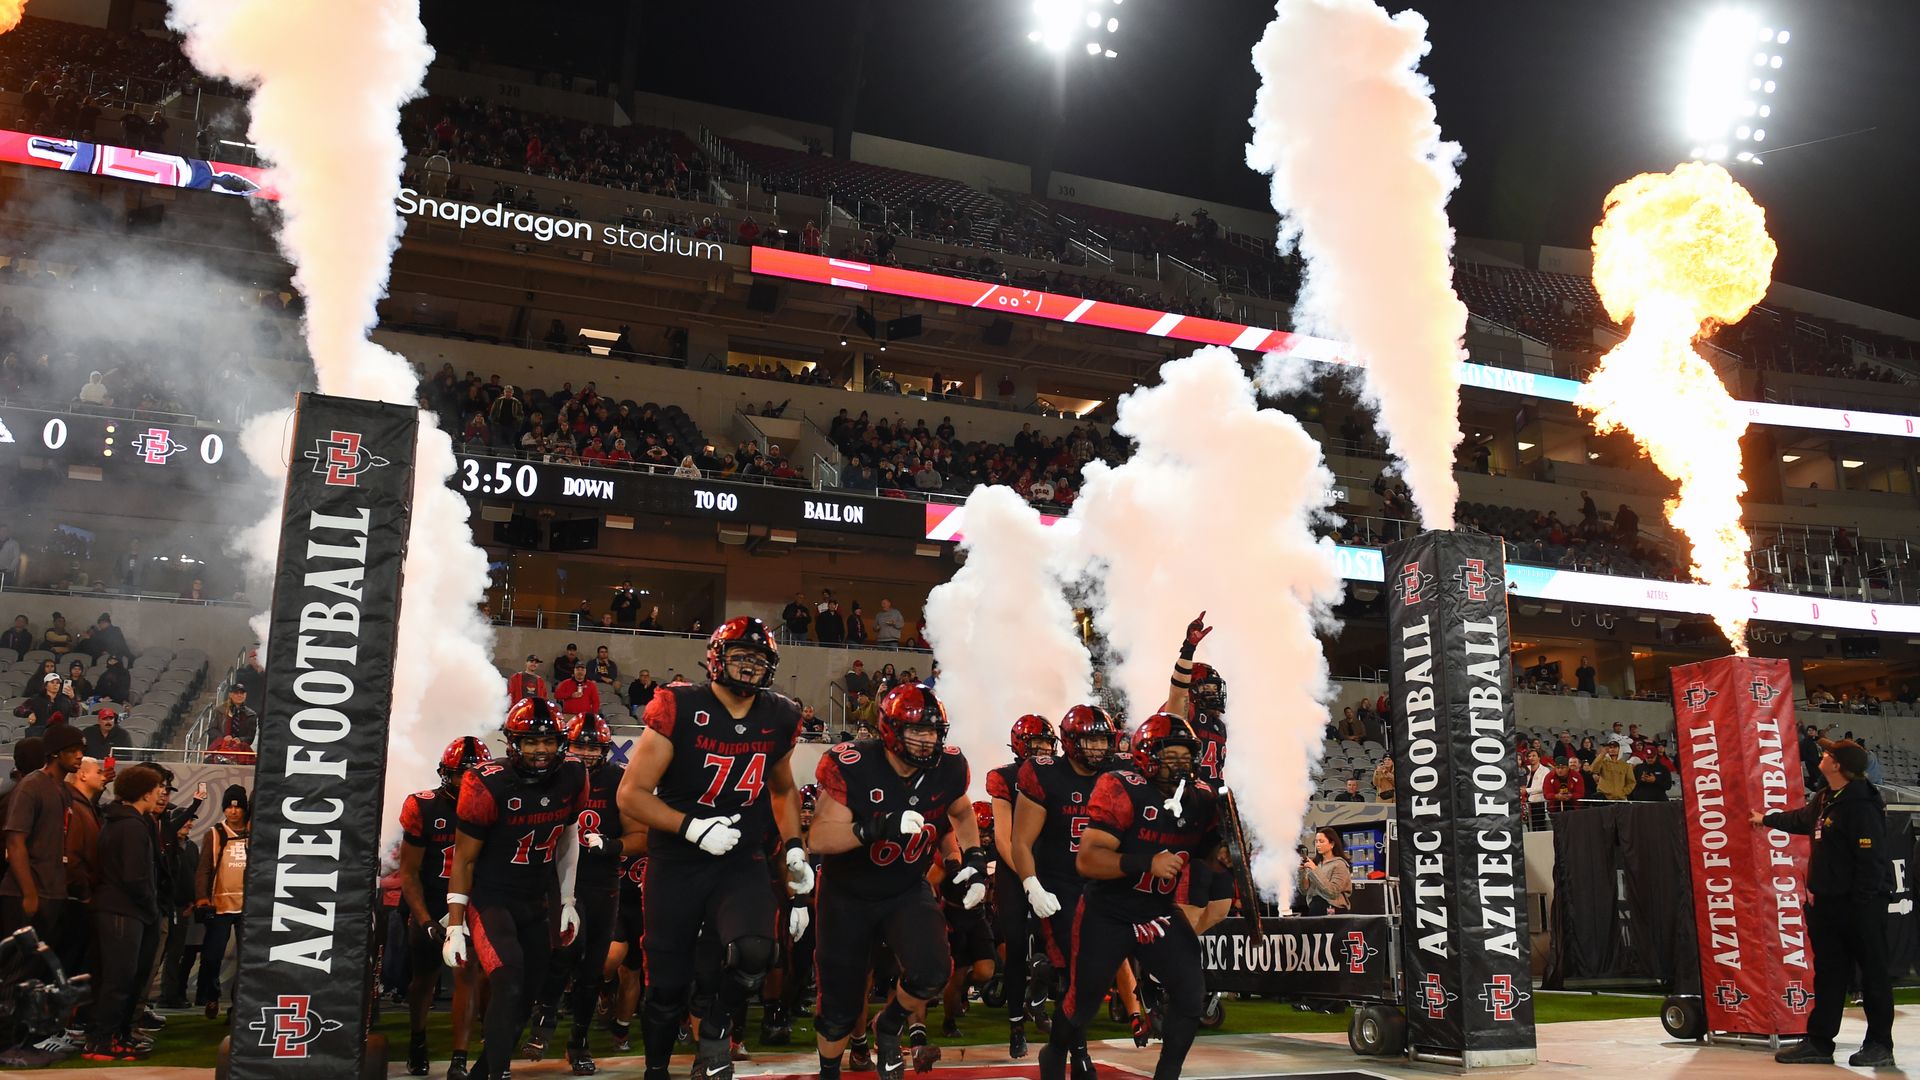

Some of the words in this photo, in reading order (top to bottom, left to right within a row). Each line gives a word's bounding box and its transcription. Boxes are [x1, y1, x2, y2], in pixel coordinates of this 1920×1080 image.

[1057, 184, 1076, 198] 330
[395, 187, 593, 241] Snapdragon
[602, 223, 724, 261] stadium
[42, 418, 68, 450] 0
[200, 434, 224, 464] 0
[461, 458, 538, 497] 3:50
[562, 476, 614, 500] DOWN
[694, 490, 716, 509] TO
[717, 491, 738, 512] GO
[803, 501, 842, 523] BALL
[843, 504, 864, 525] ON
[1646, 589, 1669, 601] AZTECS
[284, 507, 371, 780] FOOTBALL
[1402, 614, 1442, 819] FOOTBALL
[1463, 615, 1510, 818] FOOTBALL
[694, 734, 717, 750] SAN
[717, 741, 749, 756] DIEGO
[697, 752, 767, 808] 74
[1689, 720, 1731, 869] FOOTBALL
[1756, 718, 1794, 867] FOTBALL
[510, 824, 564, 865] 14
[577, 809, 601, 848] 8
[268, 796, 345, 975] AZTEC
[1412, 830, 1448, 960] AZTEC
[1476, 830, 1520, 960] AZTEC
[1705, 877, 1742, 971] AZTEC
[1772, 876, 1809, 970] AZTEC
[1231, 932, 1341, 972] FOOTBALL
